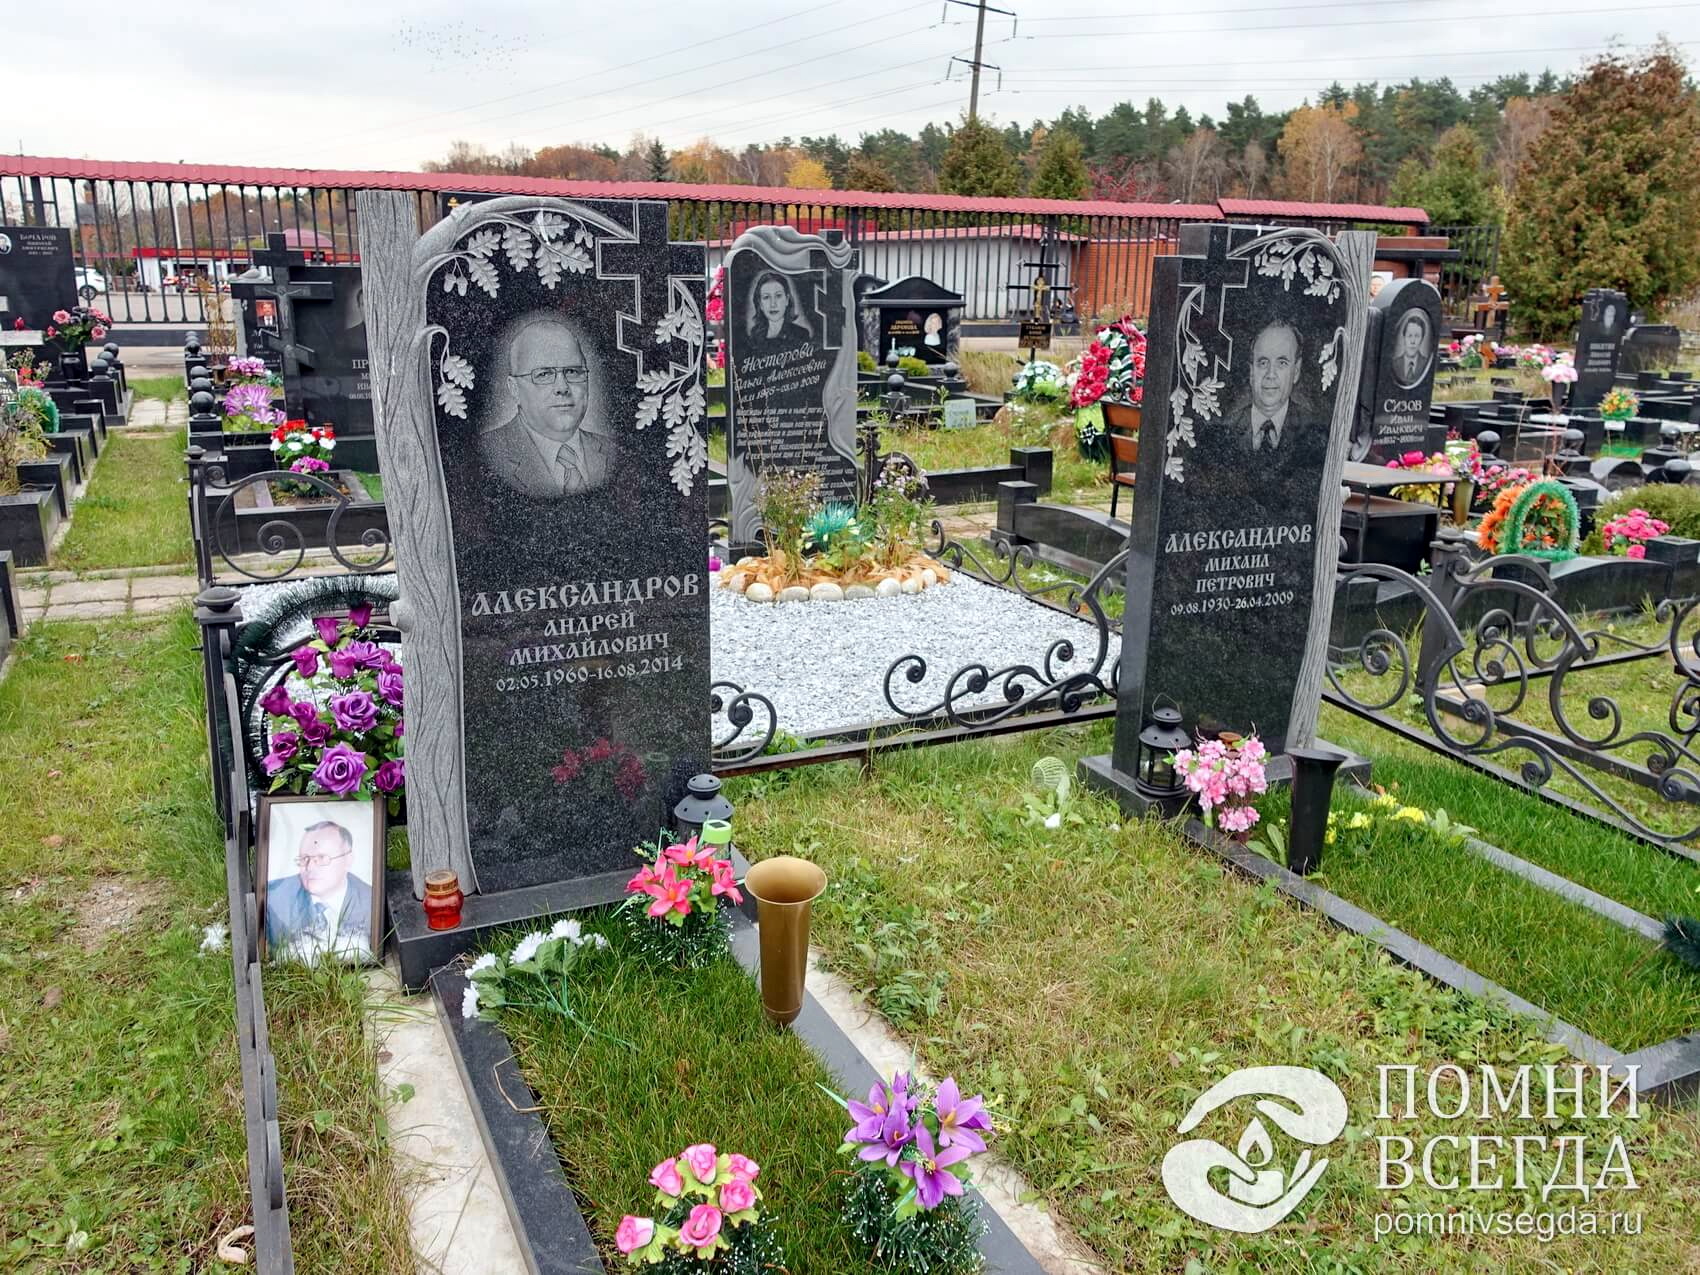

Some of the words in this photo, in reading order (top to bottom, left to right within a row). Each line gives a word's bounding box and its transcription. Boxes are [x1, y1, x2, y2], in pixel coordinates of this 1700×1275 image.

[1383, 398, 1423, 413] СИЗОВ
[1164, 524, 1312, 553] АЛЕКСАНДРОВ
[1204, 553, 1270, 572] МИХАИЛ
[471, 573, 700, 616] АЛЕКСАНДРОВ
[1195, 573, 1276, 593] ПЕТРОВИЧ
[543, 609, 636, 637] АНДРЕЙ
[509, 632, 669, 666] МИХАЙЛОВИЧ
